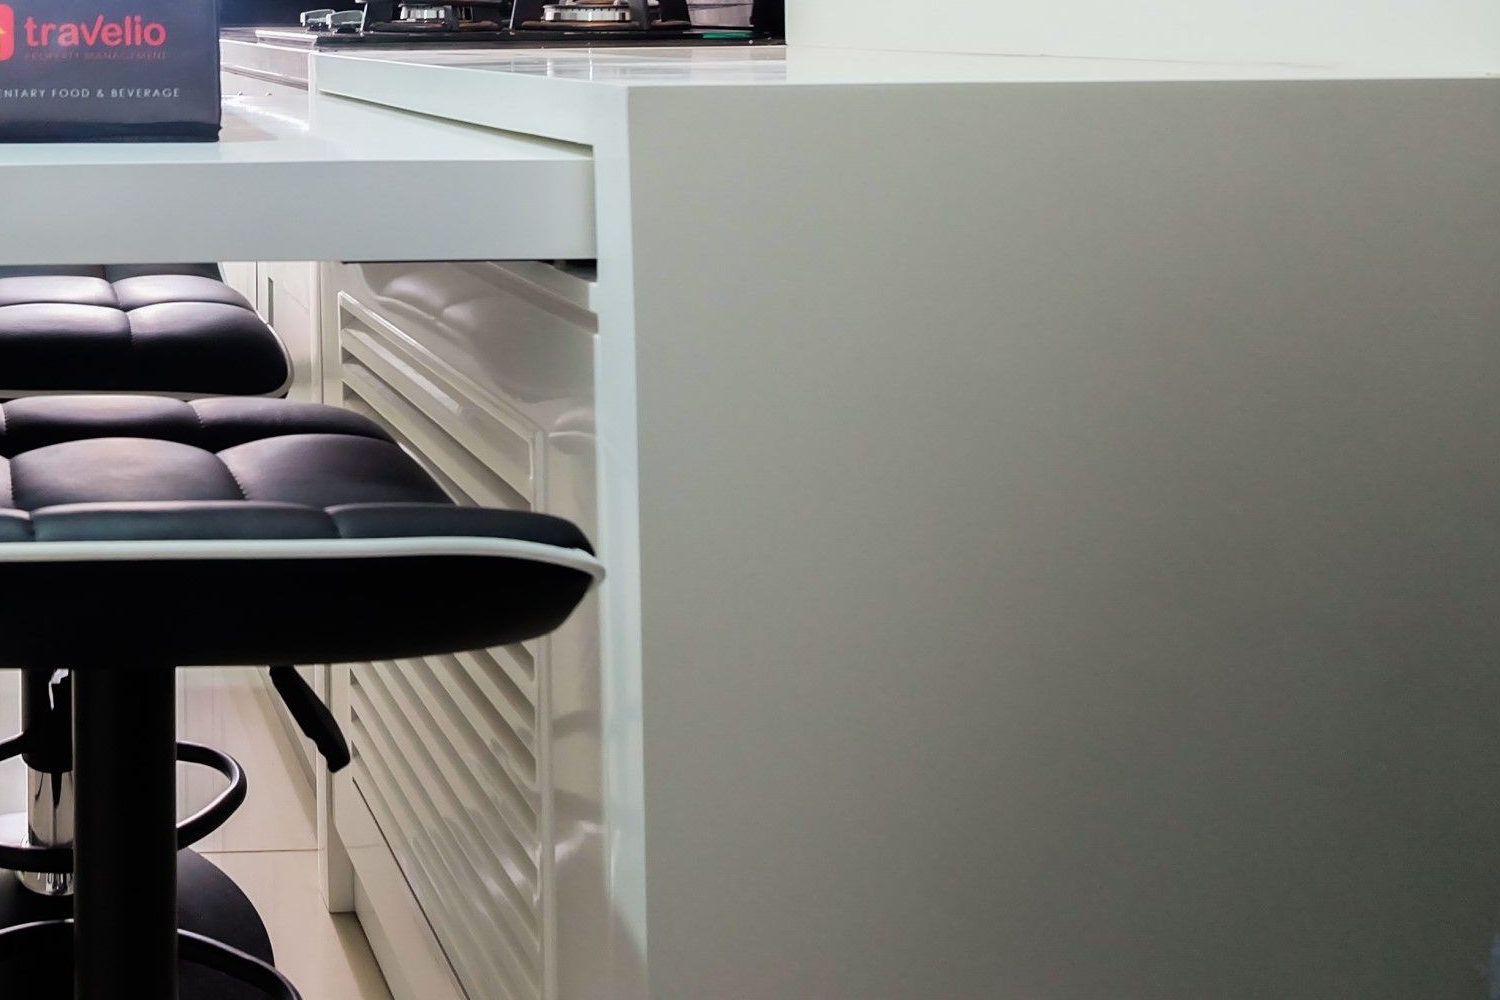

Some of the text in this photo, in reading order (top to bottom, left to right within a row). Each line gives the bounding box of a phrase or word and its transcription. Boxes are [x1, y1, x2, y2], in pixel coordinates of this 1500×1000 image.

[51, 88, 90, 99] FOOD
[96, 88, 105, 99] &
[111, 88, 180, 99] BEVERAGE
